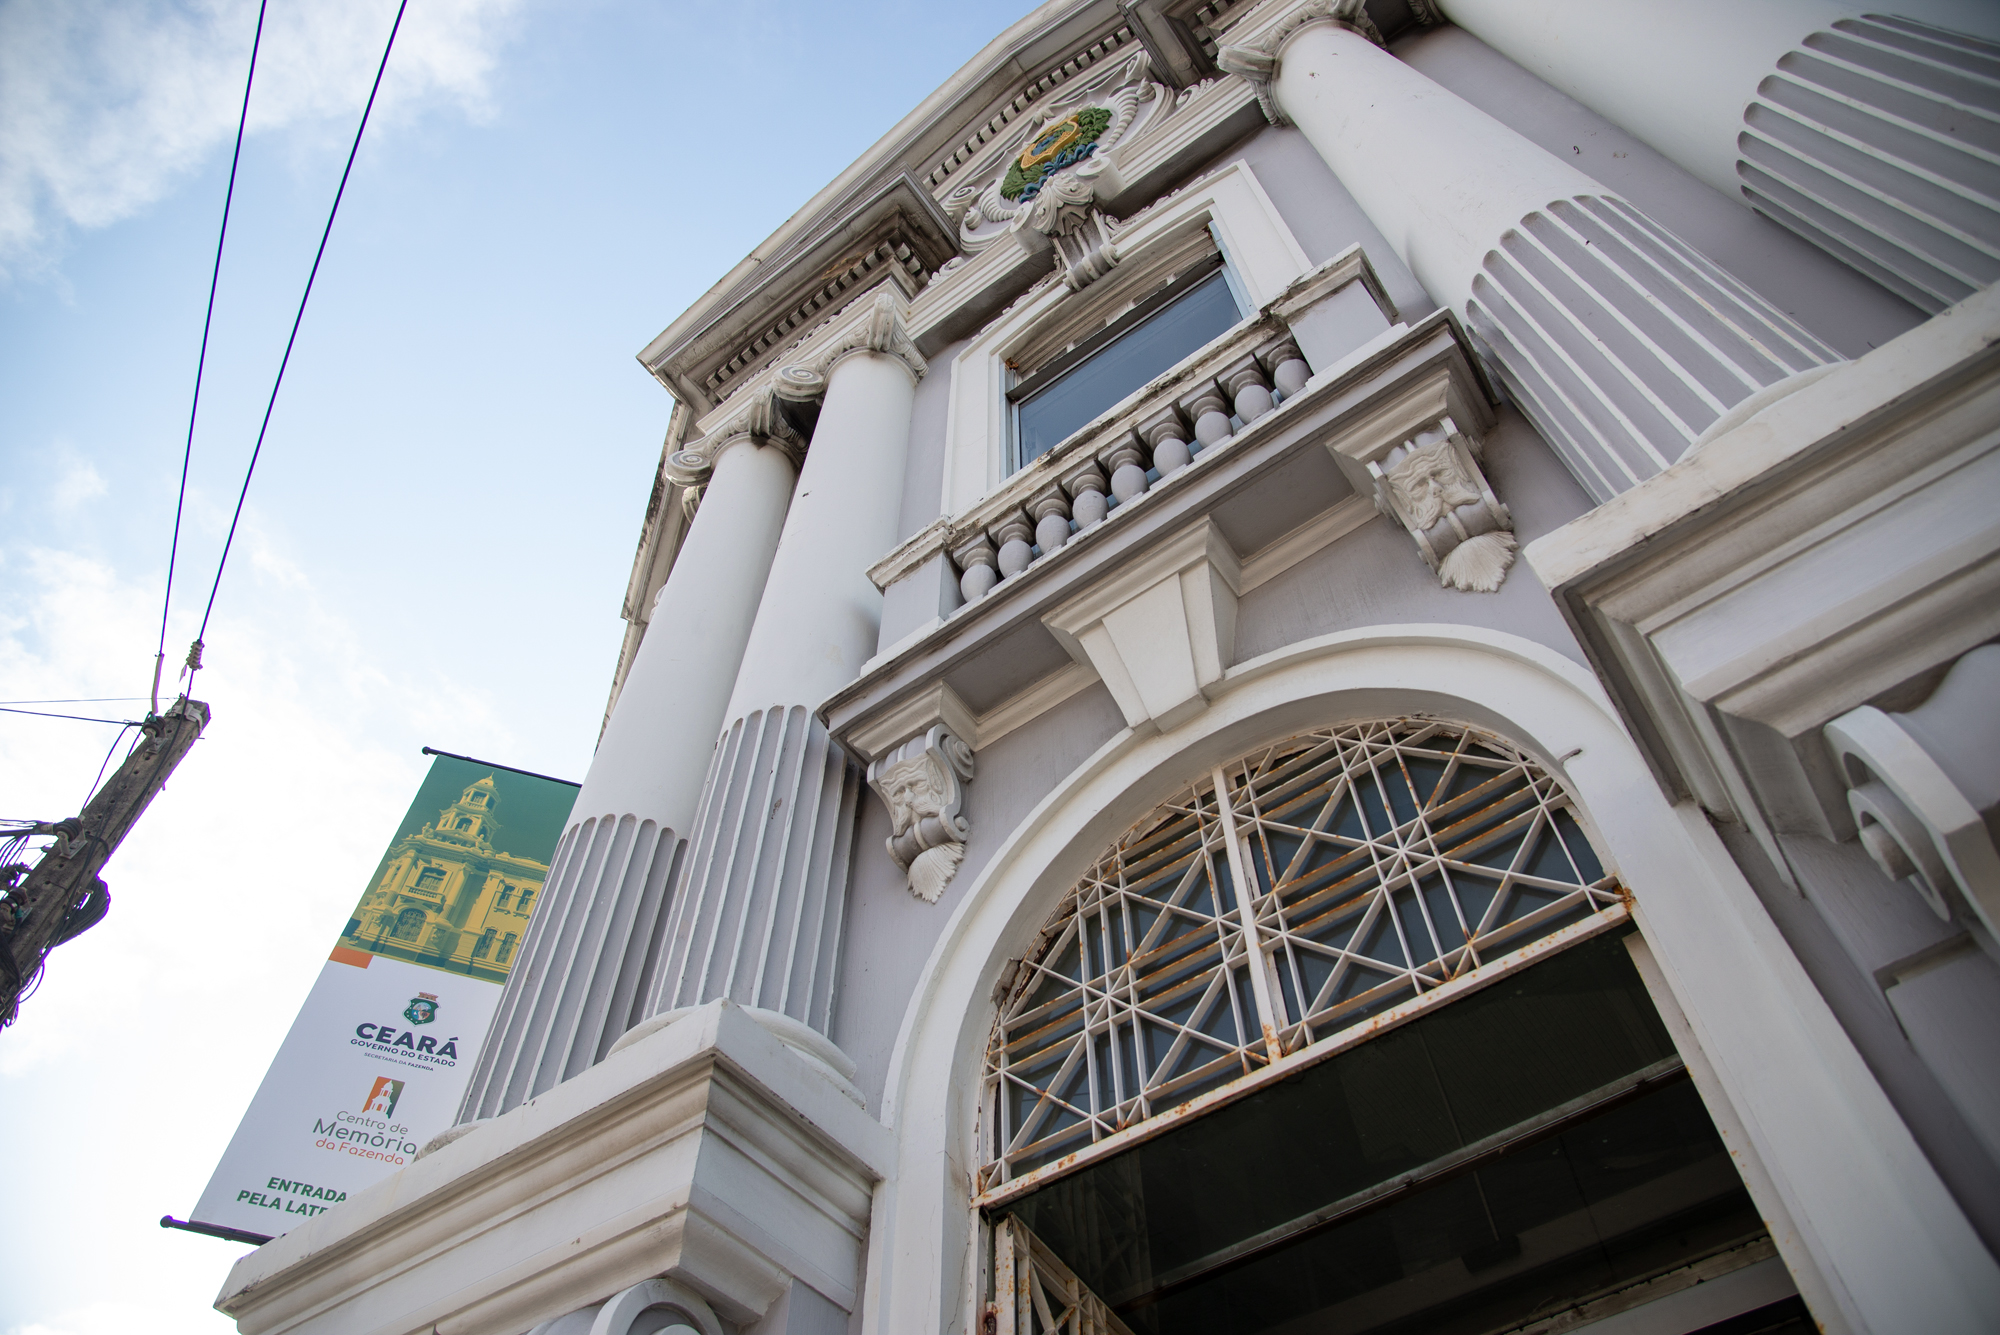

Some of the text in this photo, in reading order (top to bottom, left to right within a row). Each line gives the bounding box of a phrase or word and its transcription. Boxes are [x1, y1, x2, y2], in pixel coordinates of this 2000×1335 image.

[350, 1038, 456, 1067] GOVERNO DO ESTADO
[356, 1023, 458, 1060] CEARÁ
[364, 1052, 398, 1064] SECRETARIA
[407, 1062, 434, 1071] FAZENDA
[336, 1110, 409, 1135] Centro de
[315, 1138, 404, 1165] da Fazenda
[236, 1189, 281, 1210] PELA
[267, 1176, 347, 1203] ENTRADA
